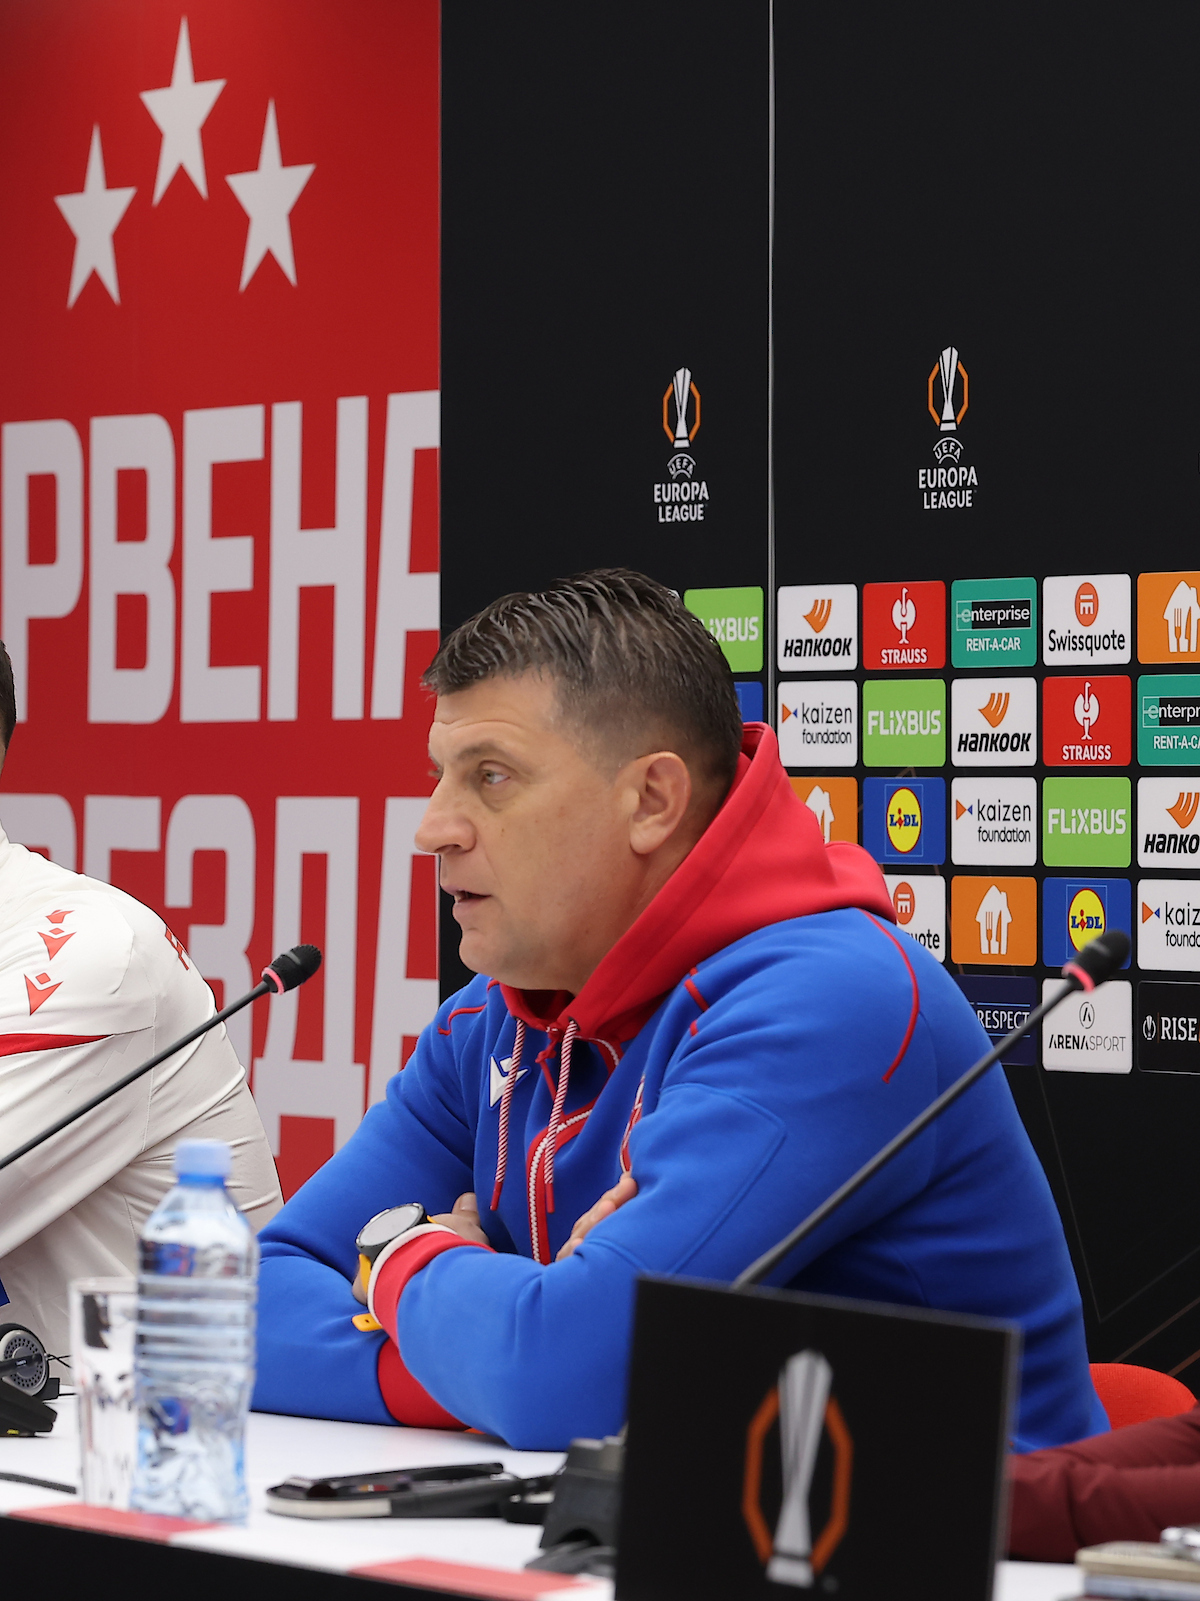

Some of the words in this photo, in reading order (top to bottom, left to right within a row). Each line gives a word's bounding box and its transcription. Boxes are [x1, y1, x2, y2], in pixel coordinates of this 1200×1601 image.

[934, 441, 961, 460] UEFA
[668, 457, 694, 475] UEFA
[918, 465, 979, 489] EUROPA
[653, 480, 710, 503] EUROPA
[923, 489, 973, 509] LEAGUE
[658, 503, 705, 523] LEAGUE
[960, 604, 1030, 625] enterprise
[966, 636, 1021, 652] RENT-A-CAR
[1048, 629, 1126, 657] Swissquote
[880, 648, 928, 665] STRAUSS
[801, 702, 852, 724] kaizen
[802, 728, 852, 744] foundation
[1062, 744, 1112, 761] STRAUSS
[977, 798, 1032, 822] kaizen
[977, 826, 1031, 843] foundation
[976, 1010, 1031, 1030] RESPECT
[1161, 1016, 1198, 1041] RISE
